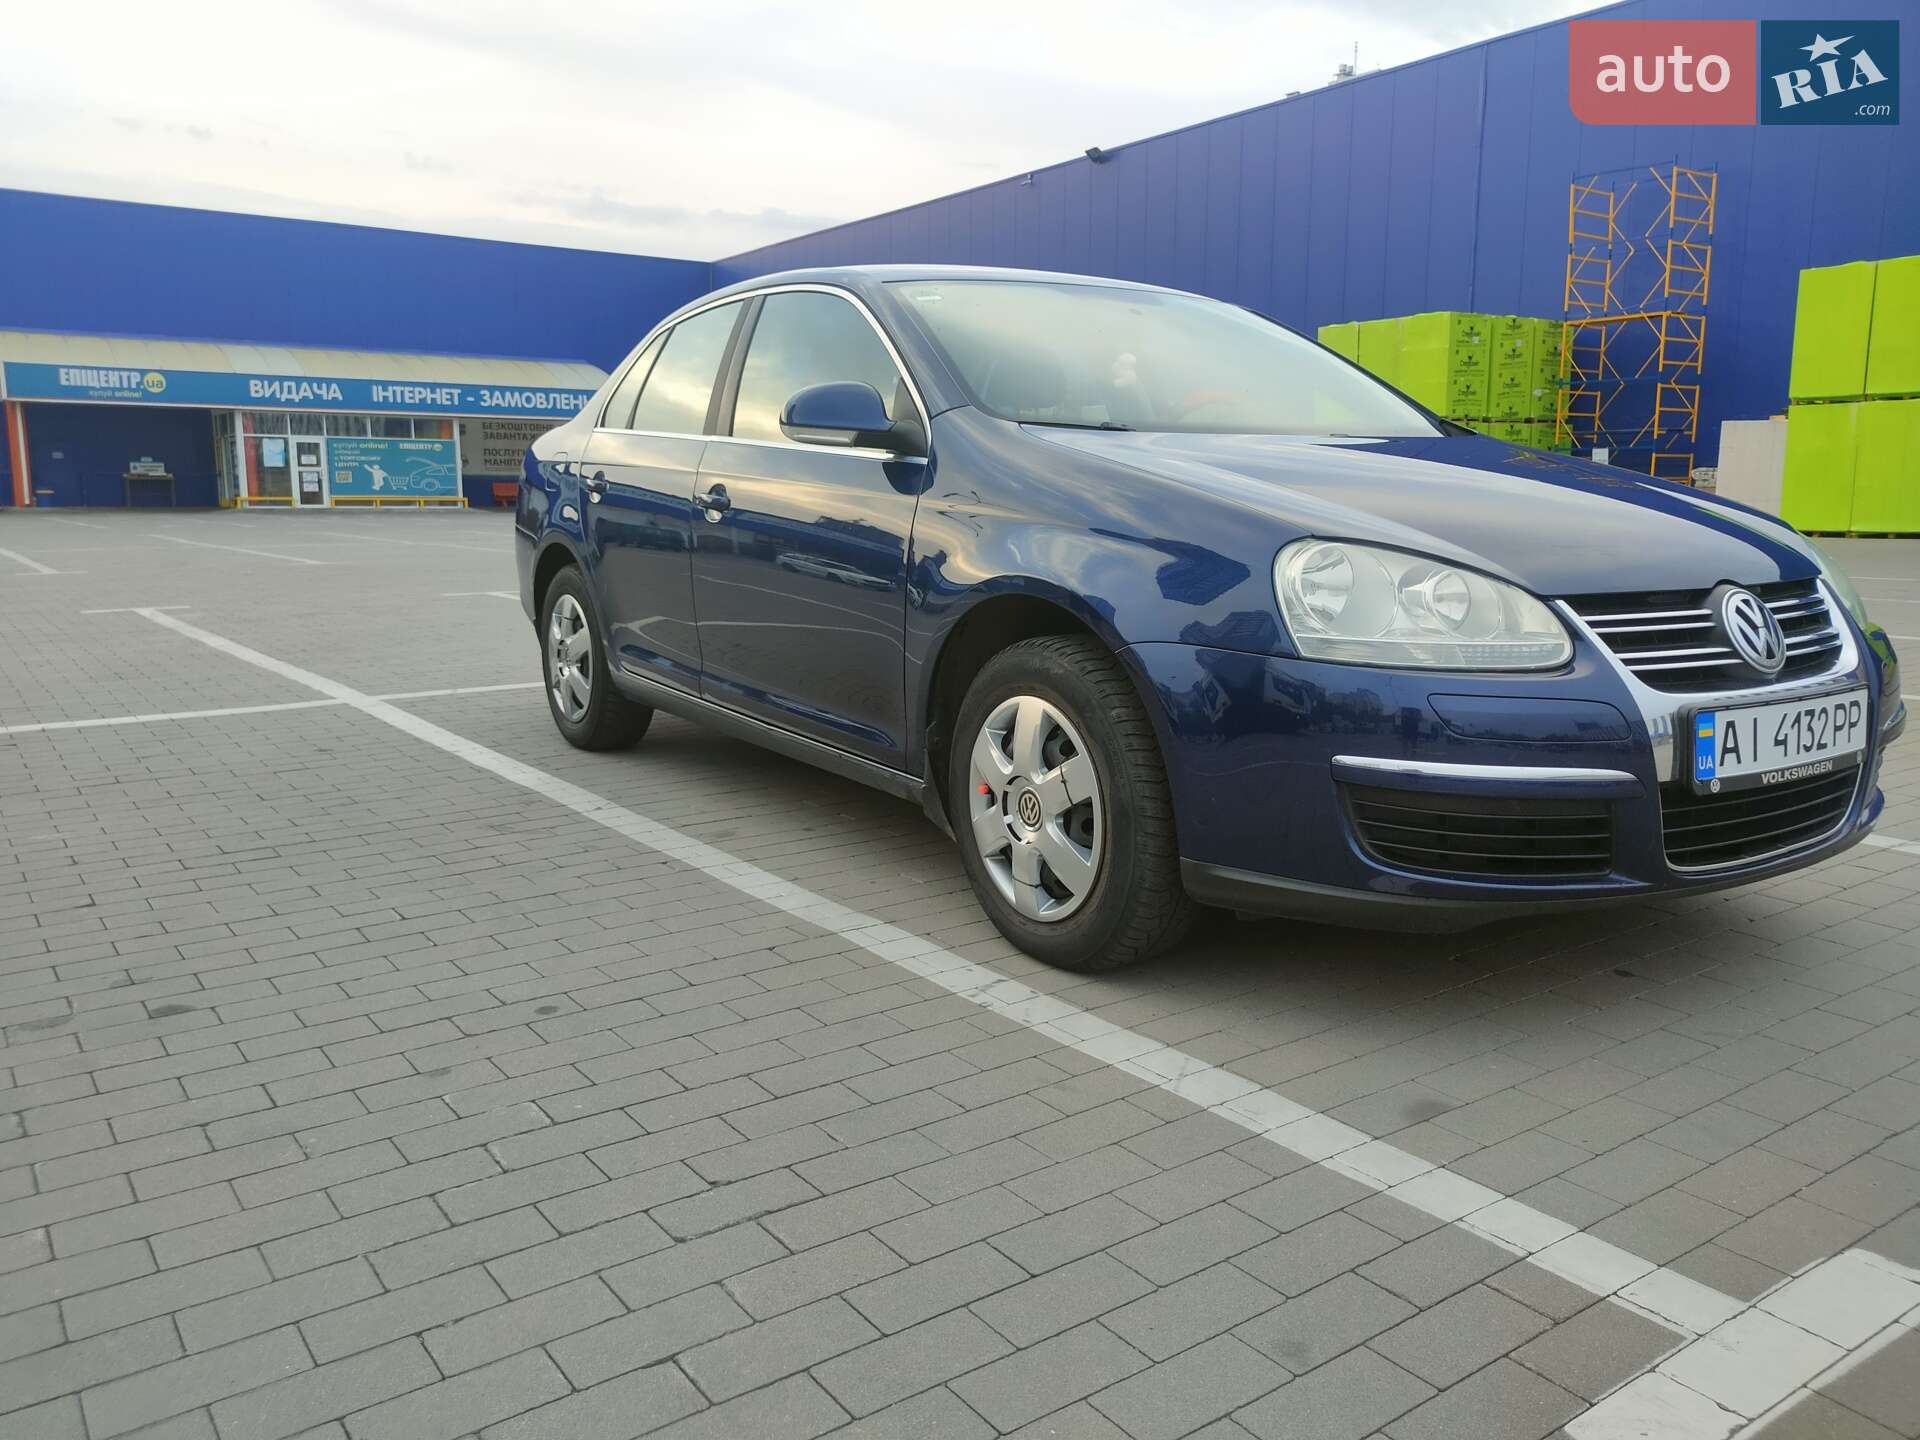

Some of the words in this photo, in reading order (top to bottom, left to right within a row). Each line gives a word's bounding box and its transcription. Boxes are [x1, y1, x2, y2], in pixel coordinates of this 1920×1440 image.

[249, 379, 342, 402] ВИДАЧА
[372, 383, 461, 406] ІНТЕРНЕТ
[1698, 755, 1714, 770] UA
[1761, 760, 1833, 785] VOLKSWAGEN
